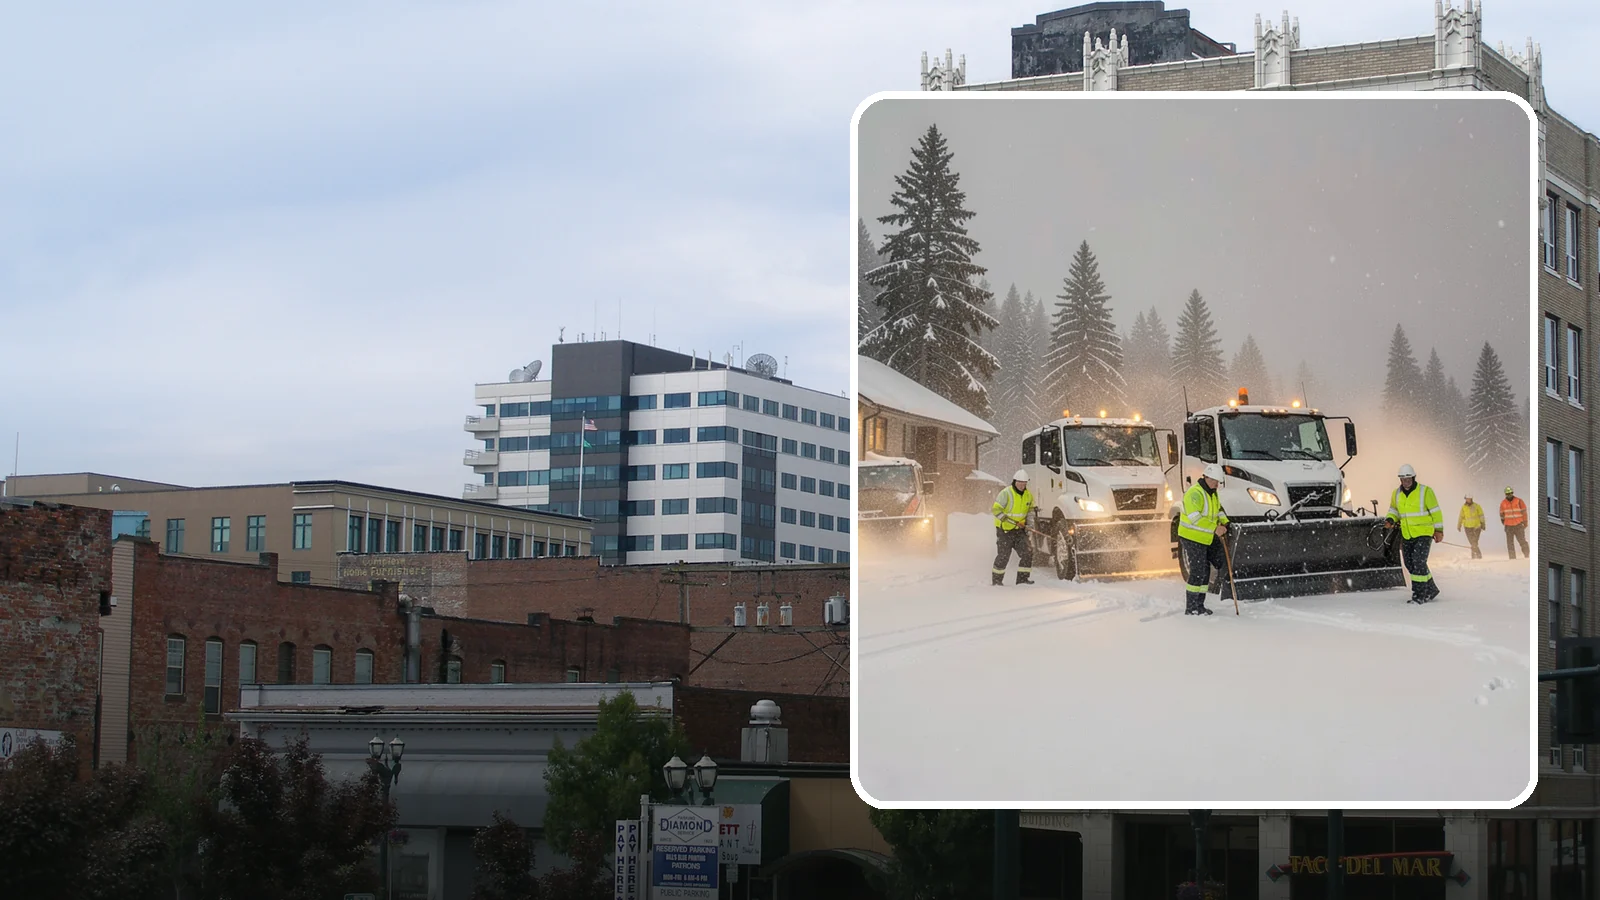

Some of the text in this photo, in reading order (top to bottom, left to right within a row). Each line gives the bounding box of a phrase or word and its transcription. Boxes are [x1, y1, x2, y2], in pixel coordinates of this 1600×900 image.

[370, 566, 427, 576] Furnishers
[660, 818, 713, 833] DIAMOND
[1022, 815, 1070, 828] BUILDING
[616, 825, 625, 893] PAY HERE
[627, 824, 636, 893] PAY HERE
[721, 851, 739, 862] Soup
[1288, 855, 1442, 877] TAC DEL MAR
[660, 888, 710, 898] PUBLIC PARKING
